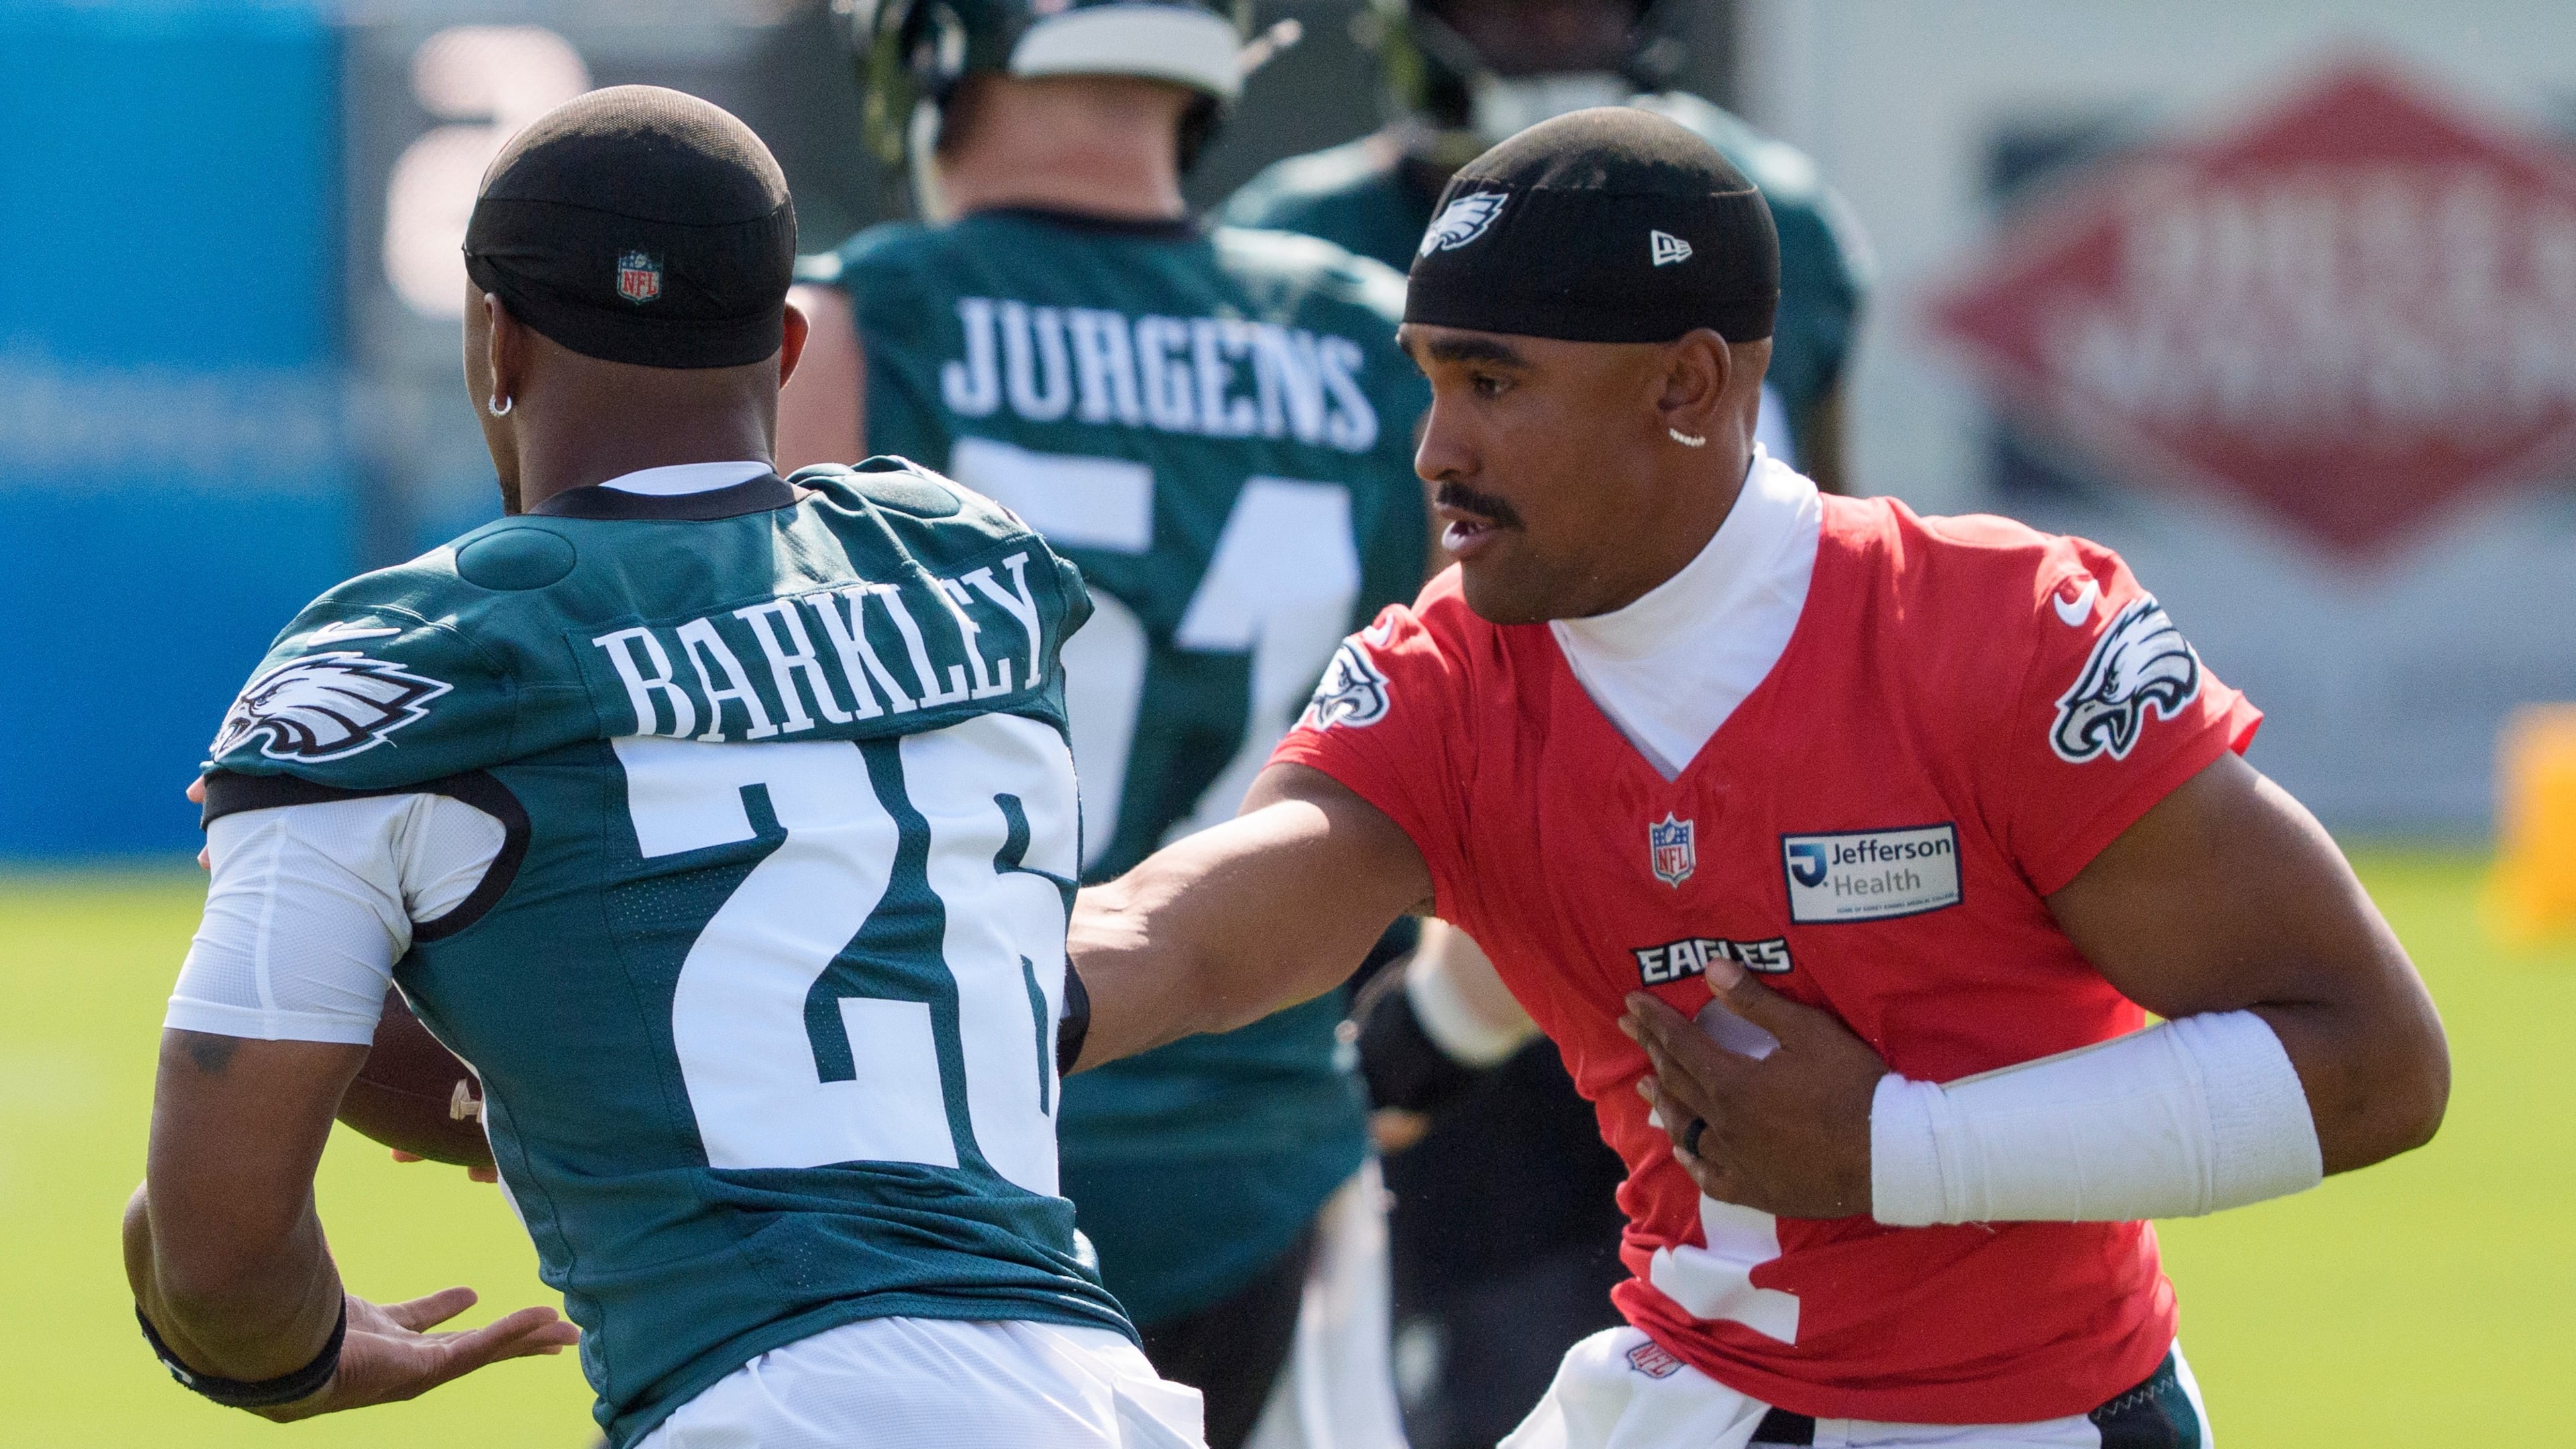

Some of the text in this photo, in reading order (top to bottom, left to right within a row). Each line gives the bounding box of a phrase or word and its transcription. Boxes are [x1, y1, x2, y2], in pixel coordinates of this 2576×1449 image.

[623, 270, 658, 297] NFL
[943, 297, 1380, 454] JURGENS
[592, 552, 1041, 743] BARKLEY
[949, 436, 1362, 870] 51
[1658, 847, 1687, 873] NFL
[1832, 839, 1951, 865] Jefferson
[1833, 868, 1921, 896] Health
[610, 712, 1079, 1197] 26
[1631, 1344, 1675, 1375] NFL
